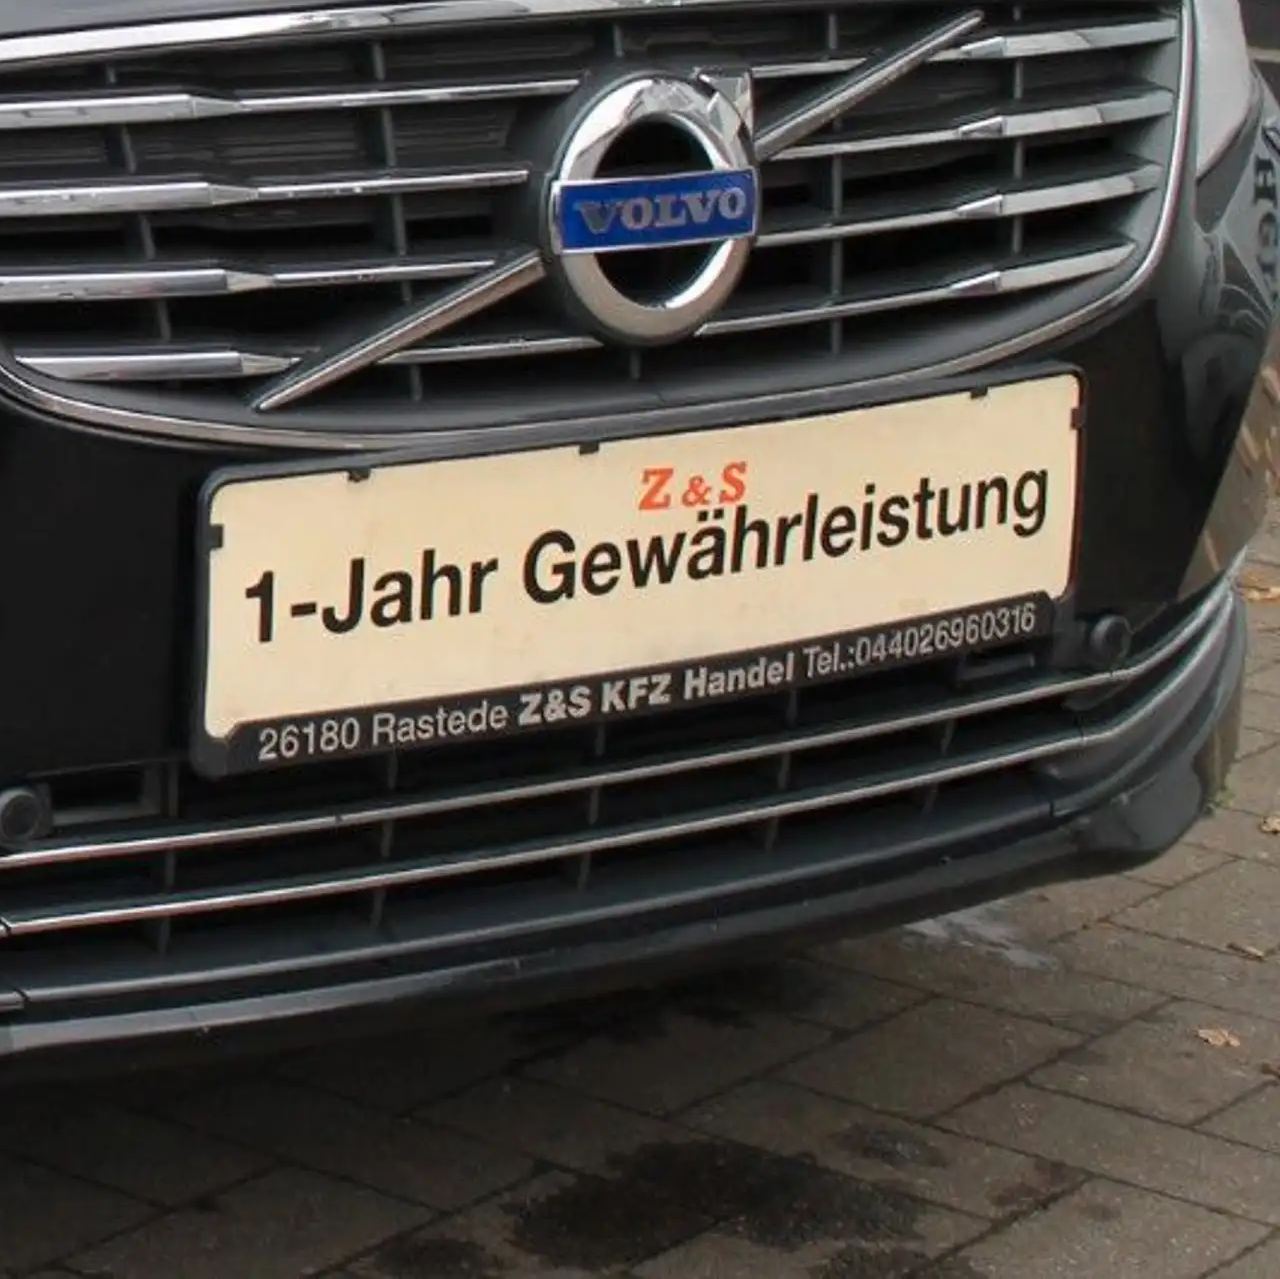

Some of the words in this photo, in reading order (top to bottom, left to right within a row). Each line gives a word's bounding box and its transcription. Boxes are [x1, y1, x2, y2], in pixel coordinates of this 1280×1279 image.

[573, 186, 747, 234] VOLVO
[245, 548, 499, 643] 1-Jahr
[523, 468, 1048, 604] Gewährleistung
[258, 719, 360, 762] 26180
[372, 701, 508, 747] Rastede
[518, 686, 592, 727] Z&S
[600, 672, 672, 714] KFZ
[684, 652, 794, 701] Handel
